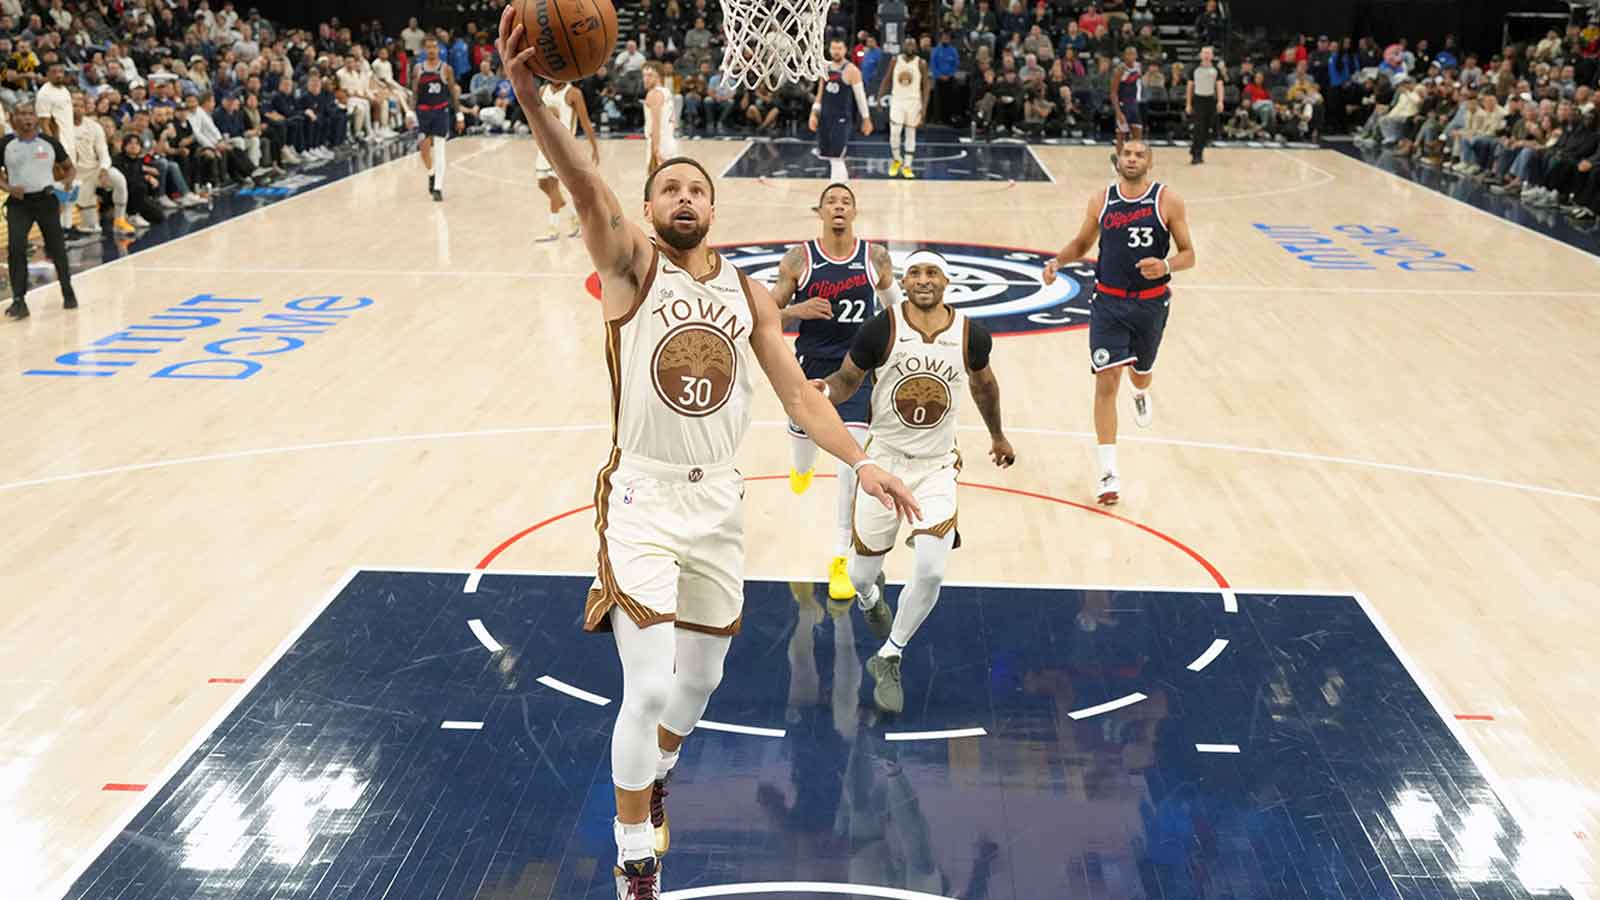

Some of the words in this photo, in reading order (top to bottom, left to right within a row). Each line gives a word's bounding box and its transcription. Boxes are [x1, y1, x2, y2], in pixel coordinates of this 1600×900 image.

[1127, 227, 1154, 248] 33
[807, 273, 867, 301] Clippers
[652, 298, 745, 340] TOWN
[837, 299, 866, 323] 22
[22, 293, 262, 377] INTUIT
[892, 355, 959, 382] TOWN
[678, 376, 712, 407] 30
[913, 406, 926, 423] 0
